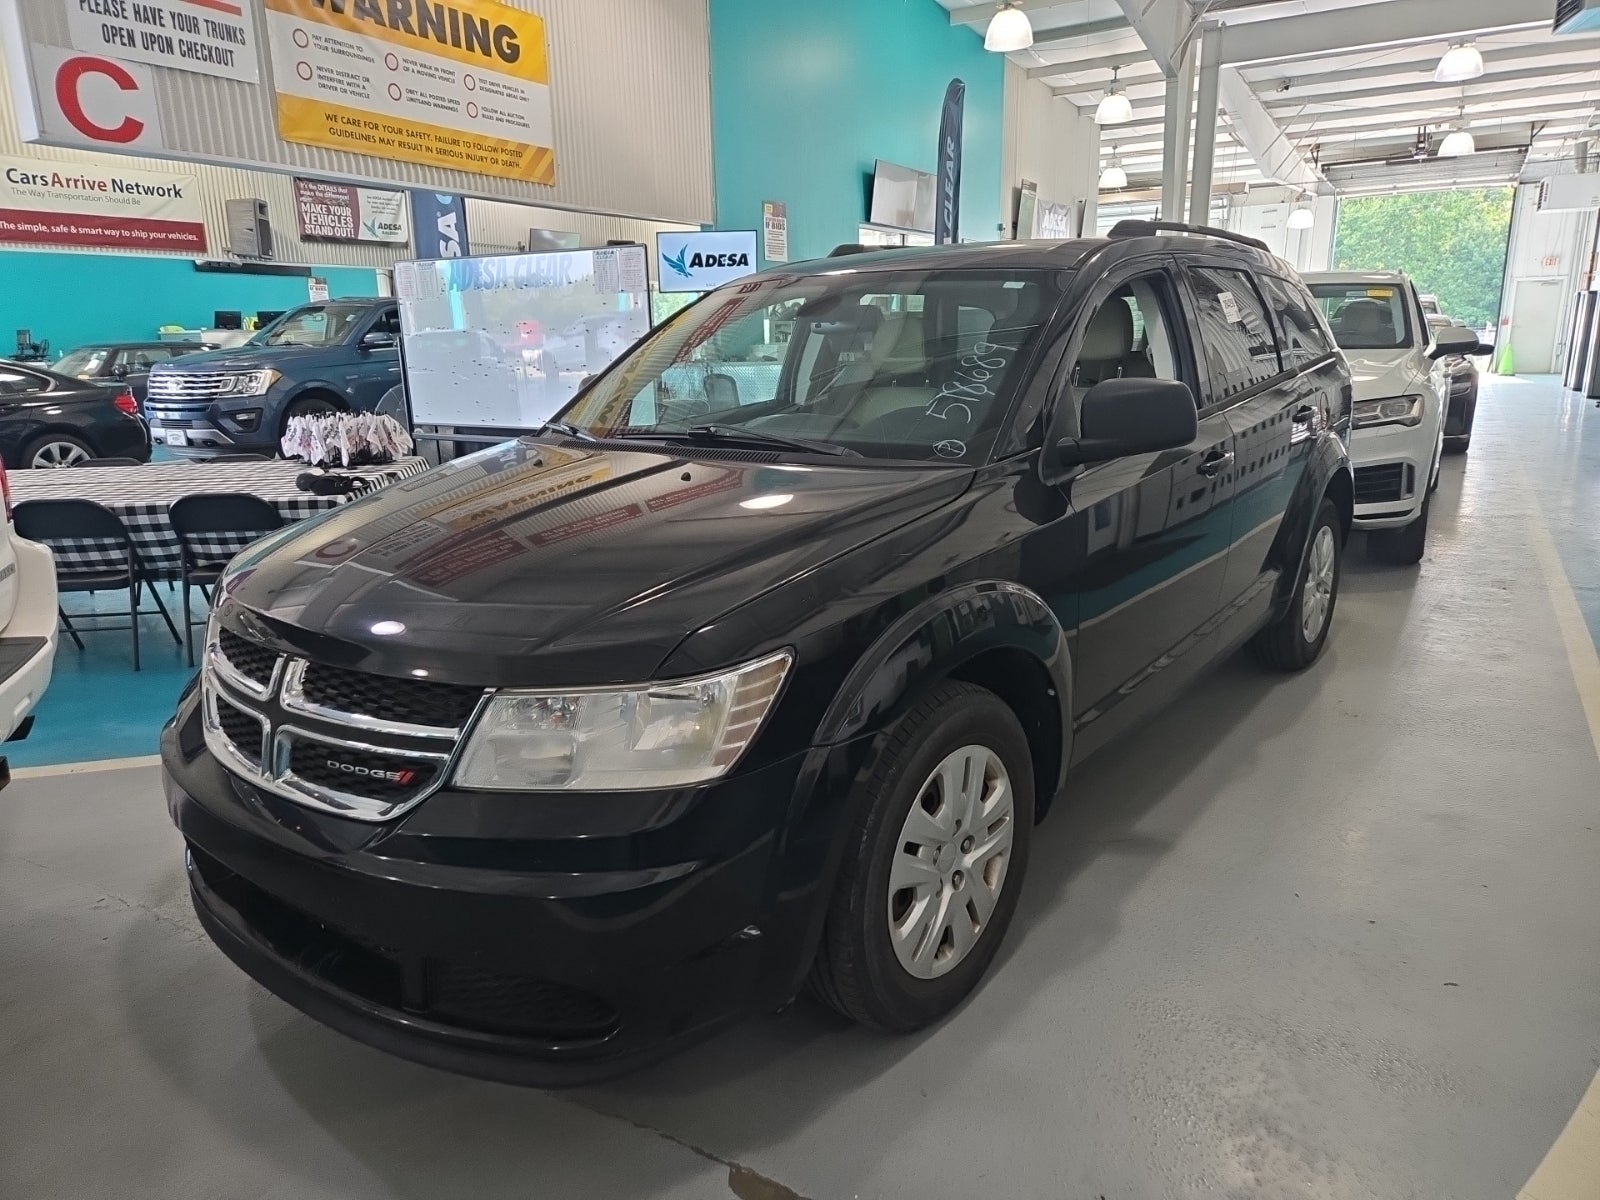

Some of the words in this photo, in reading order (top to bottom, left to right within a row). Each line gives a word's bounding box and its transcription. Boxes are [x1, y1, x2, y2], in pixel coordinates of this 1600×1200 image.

[80, 0, 128, 20] PLEASE
[133, 4, 165, 28] HAVE
[169, 11, 200, 35] YOUR
[203, 19, 246, 46] TRUNKS
[102, 24, 136, 48] OPEN
[141, 34, 175, 55] UPON
[179, 41, 235, 67] CHECKOUT
[313, 42, 329, 52] YOUR
[331, 47, 375, 63] SURROUNDINGS
[324, 38, 354, 50] ATTENTION
[316, 66, 334, 74] NEVER
[336, 70, 360, 80] DISTRACT
[318, 82, 338, 92] DRIVER
[349, 90, 370, 99] VEHICLE
[346, 81, 360, 90] WITH
[55, 56, 144, 144] C
[325, 112, 338, 122] WE
[340, 116, 361, 128] CARE
[364, 120, 380, 131] FOR
[382, 124, 404, 136] YOUR
[434, 135, 460, 146] FAILURE
[462, 140, 471, 148] TO
[473, 142, 499, 154] FOLLOW
[500, 148, 523, 158] POSTED
[328, 127, 376, 144] GUIDELINES
[378, 136, 396, 146] MAY
[398, 140, 422, 152] RESULT
[425, 146, 433, 154] IN
[435, 148, 464, 160] SERIOUS
[466, 152, 488, 163] INJURY
[490, 157, 500, 165] OR
[111, 178, 183, 198] Network
[943, 136, 955, 231] CLEAR
[11, 187, 27, 196] The
[28, 189, 46, 198] Way
[47, 190, 104, 202] Transportation
[105, 195, 130, 205] Should
[301, 202, 328, 214] MAKE
[329, 206, 352, 217] YOUR
[302, 212, 354, 228] VEHICLES
[378, 222, 402, 232] ADESA
[0, 221, 16, 230] The
[18, 222, 50, 232] simple,
[51, 224, 68, 233] safe
[78, 226, 102, 236] smart
[104, 230, 120, 238] way
[132, 229, 148, 239] ship
[150, 232, 166, 242] your
[305, 224, 334, 236] STAND
[334, 226, 354, 238] OUT!
[689, 252, 749, 268] ADESA
[514, 254, 573, 289] CLEAR
[326, 760, 400, 781] DODGE
